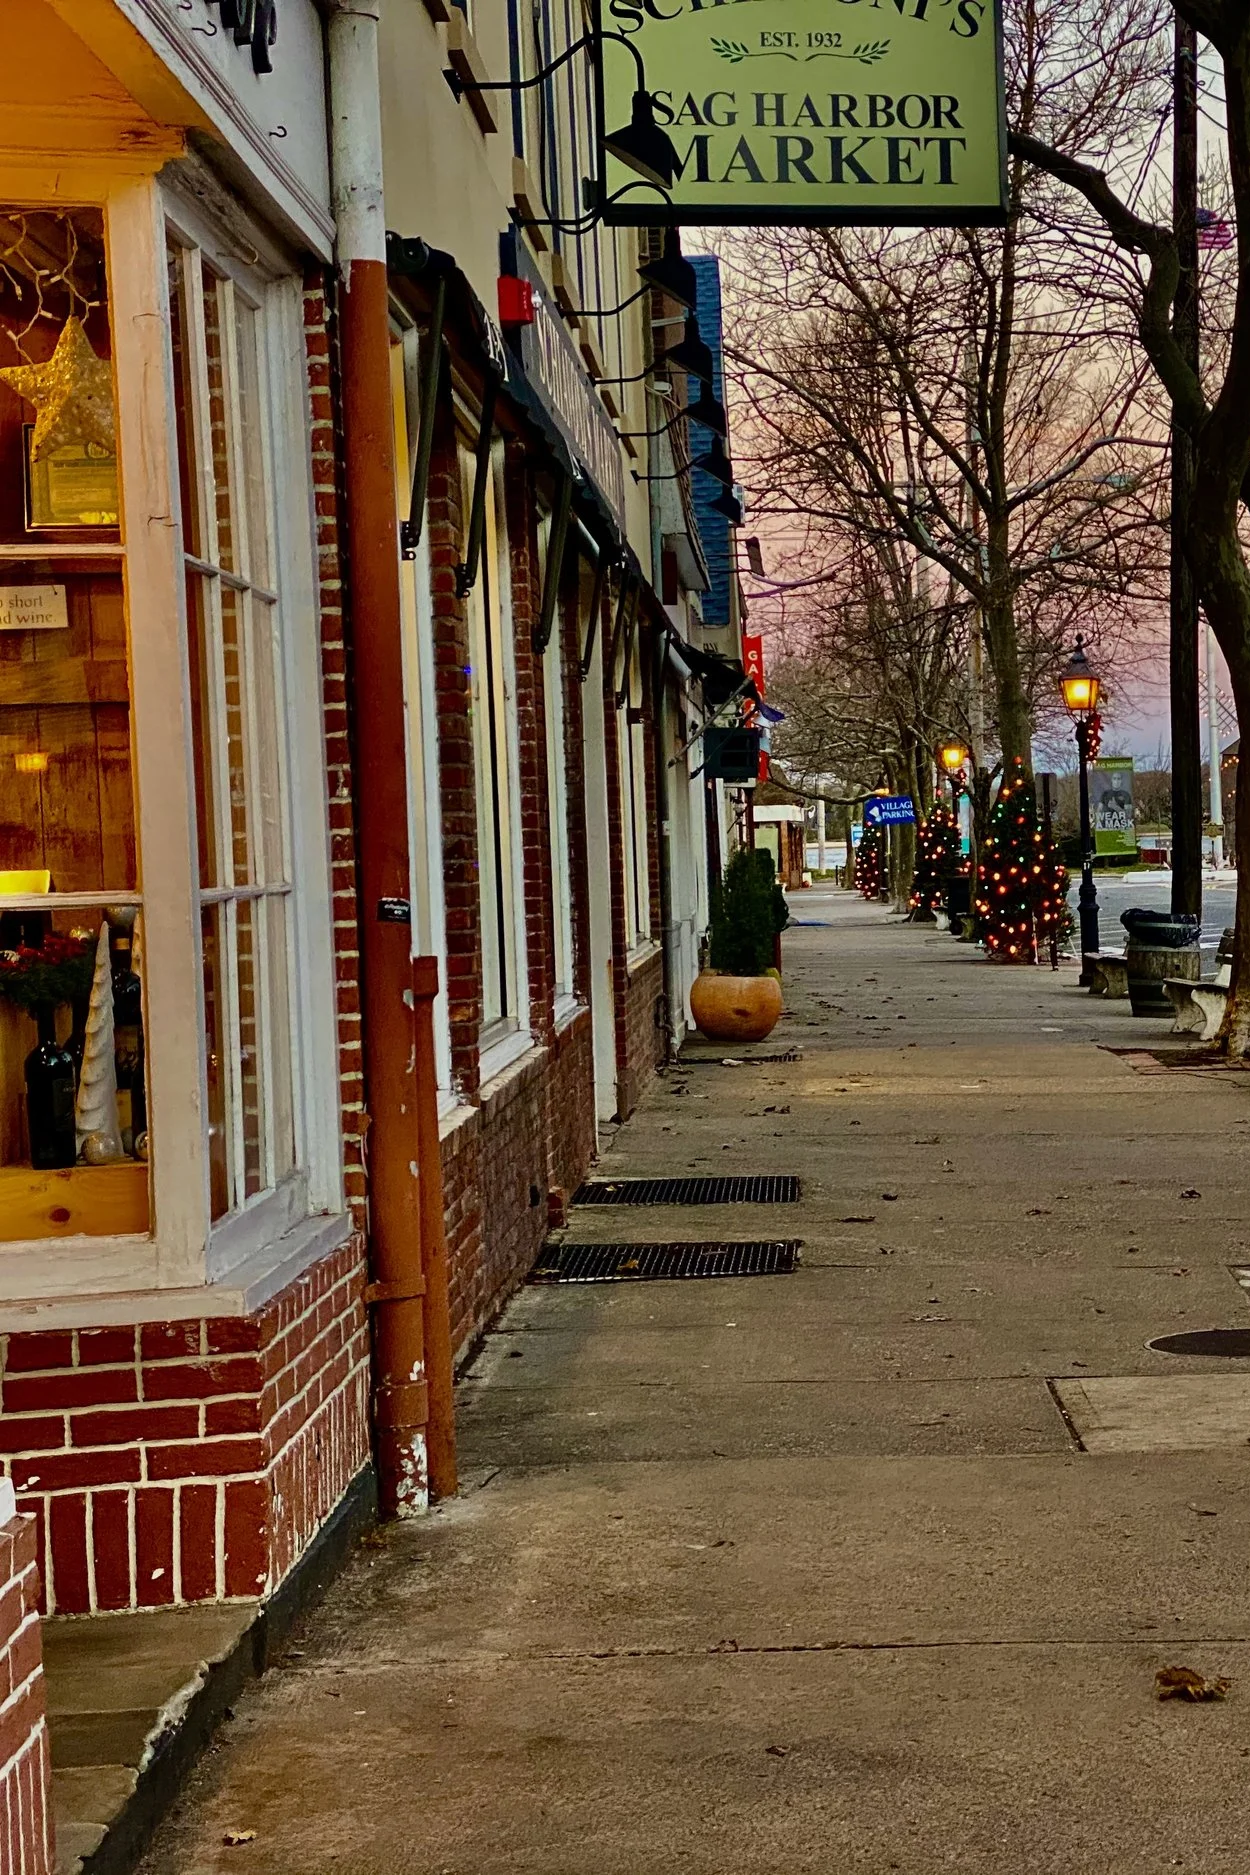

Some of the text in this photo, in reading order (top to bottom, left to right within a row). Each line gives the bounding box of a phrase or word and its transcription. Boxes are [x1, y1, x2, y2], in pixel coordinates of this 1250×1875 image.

[760, 31, 843, 48] EST. 1932
[651, 90, 965, 129] SAG HARBOR
[671, 134, 967, 185] MARKET
[8, 594, 43, 608] short
[16, 611, 57, 624] wine.
[1096, 811, 1126, 820] WEAR
[1096, 819, 1135, 829] A MASK
